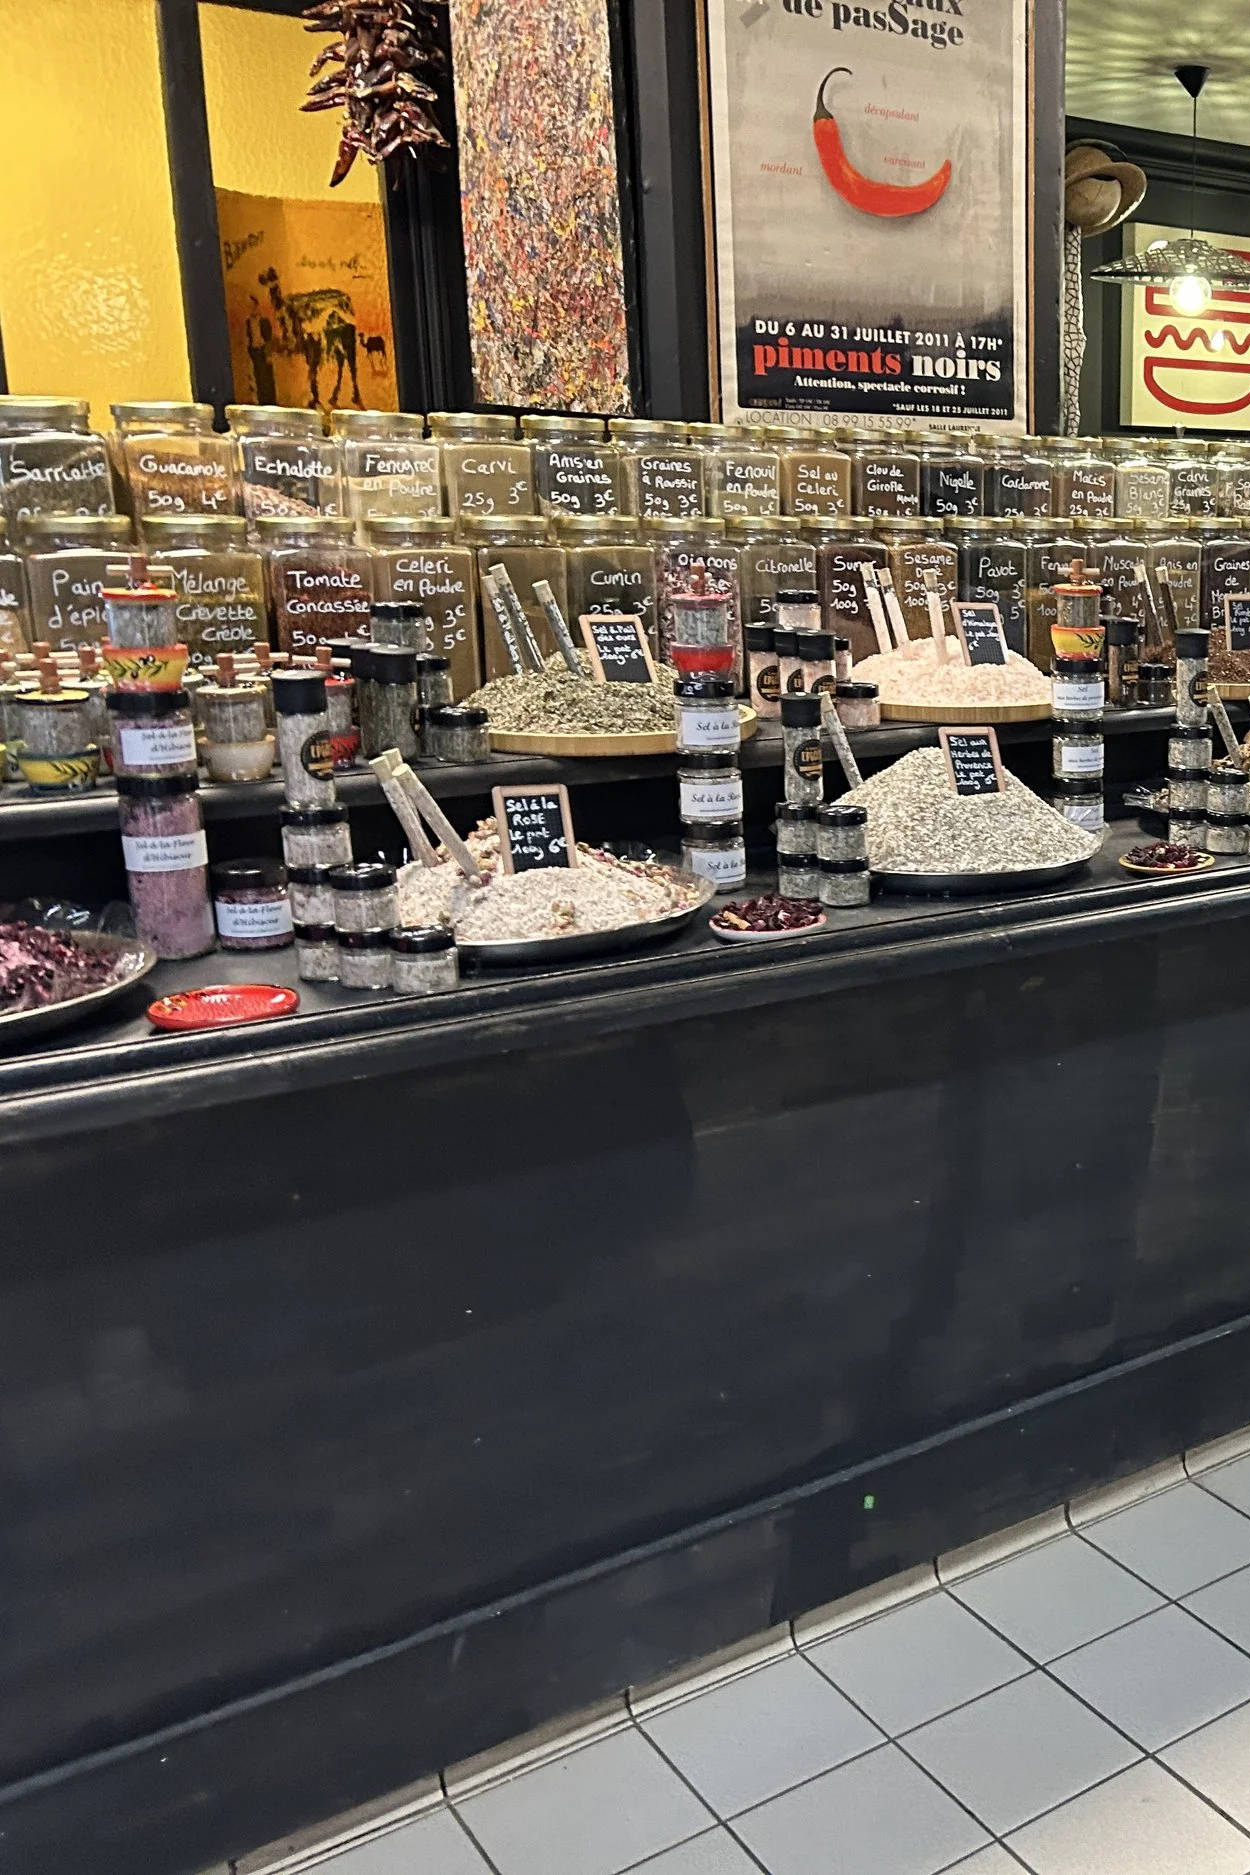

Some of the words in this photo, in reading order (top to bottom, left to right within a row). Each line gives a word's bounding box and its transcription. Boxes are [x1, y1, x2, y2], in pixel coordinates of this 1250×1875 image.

[760, 162, 803, 176] mordant
[755, 319, 779, 335] DU
[785, 322, 796, 336] 6
[802, 323, 825, 339] AU
[831, 325, 849, 340] 31
[853, 326, 911, 345] JUILLET
[915, 331, 949, 348] 2011
[955, 332, 965, 349] À
[752, 337, 902, 377] piments
[911, 349, 1002, 382] noirs
[794, 375, 856, 391] Attention,
[857, 381, 912, 394] spectacle
[913, 383, 958, 396] corrosif
[917, 404, 930, 413] LES
[931, 405, 941, 414] 18
[942, 406, 951, 414] ET
[962, 406, 989, 416] JUILLET
[990, 408, 1008, 416] 2011
[745, 410, 811, 425] LOCATION
[823, 413, 839, 427] 08
[842, 415, 859, 428] 99
[862, 416, 874, 429] 15
[877, 417, 893, 430] 55
[139, 454, 227, 477] Guacamole
[254, 456, 333, 477] Echalotte
[462, 458, 518, 475] Carvi
[641, 457, 693, 473] Graines
[726, 461, 776, 479] Fenouil
[797, 464, 821, 480] Sel
[824, 471, 839, 481] au
[866, 464, 888, 476] Clou
[889, 465, 904, 477] de
[555, 471, 613, 485] Graines
[654, 477, 698, 490] Roussir
[867, 480, 905, 493] Girofle
[939, 470, 976, 493] Nigelle
[1073, 470, 1106, 487] Macis
[726, 482, 742, 493] en
[797, 482, 839, 497] Celeri
[1072, 489, 1084, 499] en
[1086, 490, 1112, 503] Poudre
[1129, 488, 1164, 498] Blanc
[1174, 486, 1211, 497] Graines
[148, 490, 185, 511] 50g
[202, 489, 227, 510] 4€
[462, 491, 494, 515] 25g
[507, 480, 528, 505] 3€
[550, 490, 581, 509] 50g
[594, 488, 616, 508] 3€
[644, 493, 670, 511] 50g
[677, 494, 698, 508] 3€
[723, 500, 749, 516] 50g
[795, 499, 819, 516] 50g
[828, 499, 845, 516] 3€
[936, 498, 959, 516] 50g
[965, 497, 979, 515] 3€
[396, 556, 454, 574] Celeri
[755, 557, 817, 574] Citronelle
[978, 557, 1018, 579] Pavot
[1186, 561, 1198, 570] en
[1214, 557, 1250, 572] Graines
[52, 569, 104, 597] Pain
[287, 570, 363, 589] Tomate
[590, 570, 643, 586] Cumin
[1225, 575, 1239, 586] de
[393, 579, 413, 592] en
[418, 578, 465, 597] Poudre
[831, 579, 856, 597] 50g
[975, 586, 1000, 603] 50g
[1011, 579, 1026, 600] 3€
[286, 600, 371, 614] Concassée
[829, 599, 859, 615] 100g
[1010, 599, 1026, 620] 5€
[443, 604, 467, 629] 3€
[444, 629, 467, 650] 5€
[949, 736, 968, 747] Sel
[981, 749, 993, 758] de
[955, 759, 994, 769] Provence
[506, 798, 529, 812] Sel
[530, 799, 541, 811] à
[541, 796, 559, 810] la
[548, 836, 570, 854] 6€
